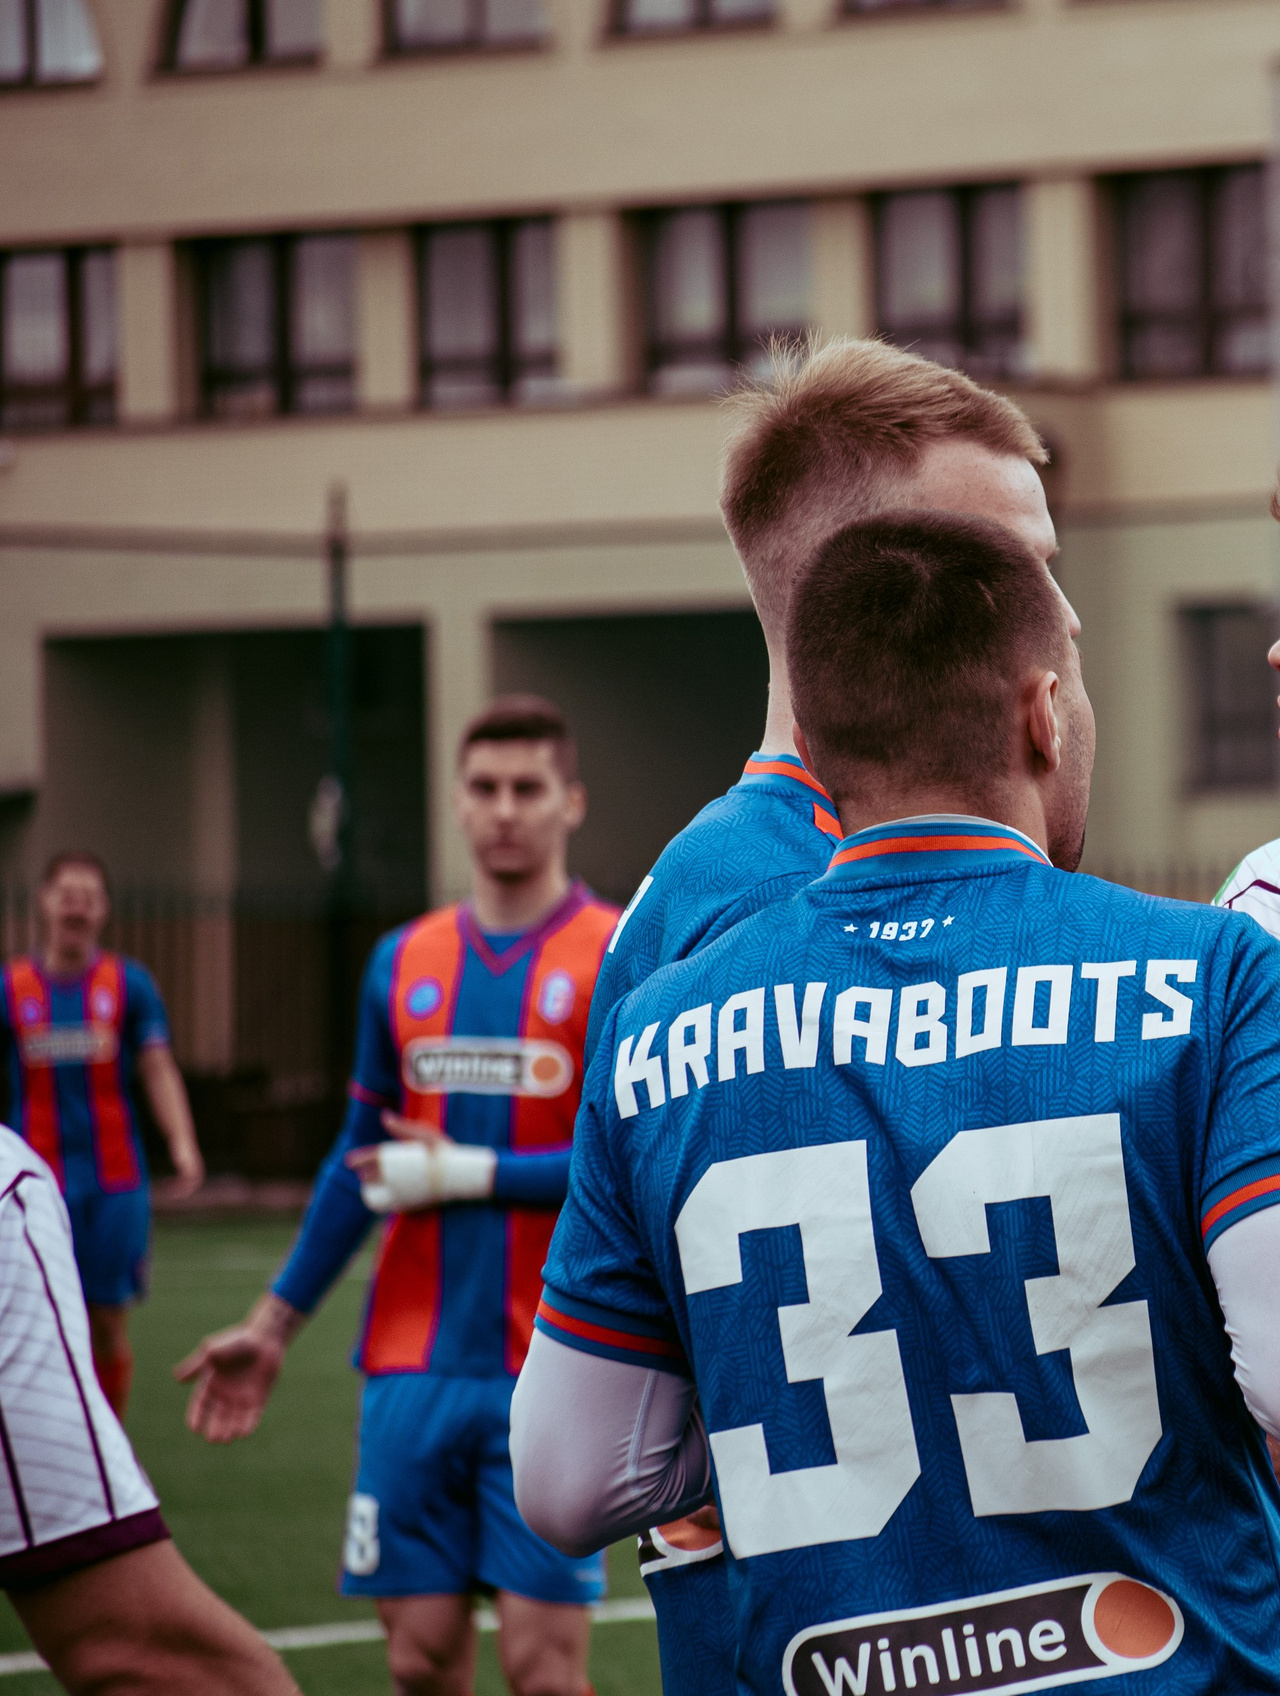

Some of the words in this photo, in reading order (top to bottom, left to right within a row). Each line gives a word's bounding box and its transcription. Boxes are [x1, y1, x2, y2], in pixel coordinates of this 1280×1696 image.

[869, 918, 935, 942] 1937
[614, 958, 1198, 1120] KRAVABOOTS
[674, 1112, 1163, 1560] 33
[811, 1623, 1067, 1696] Winline
